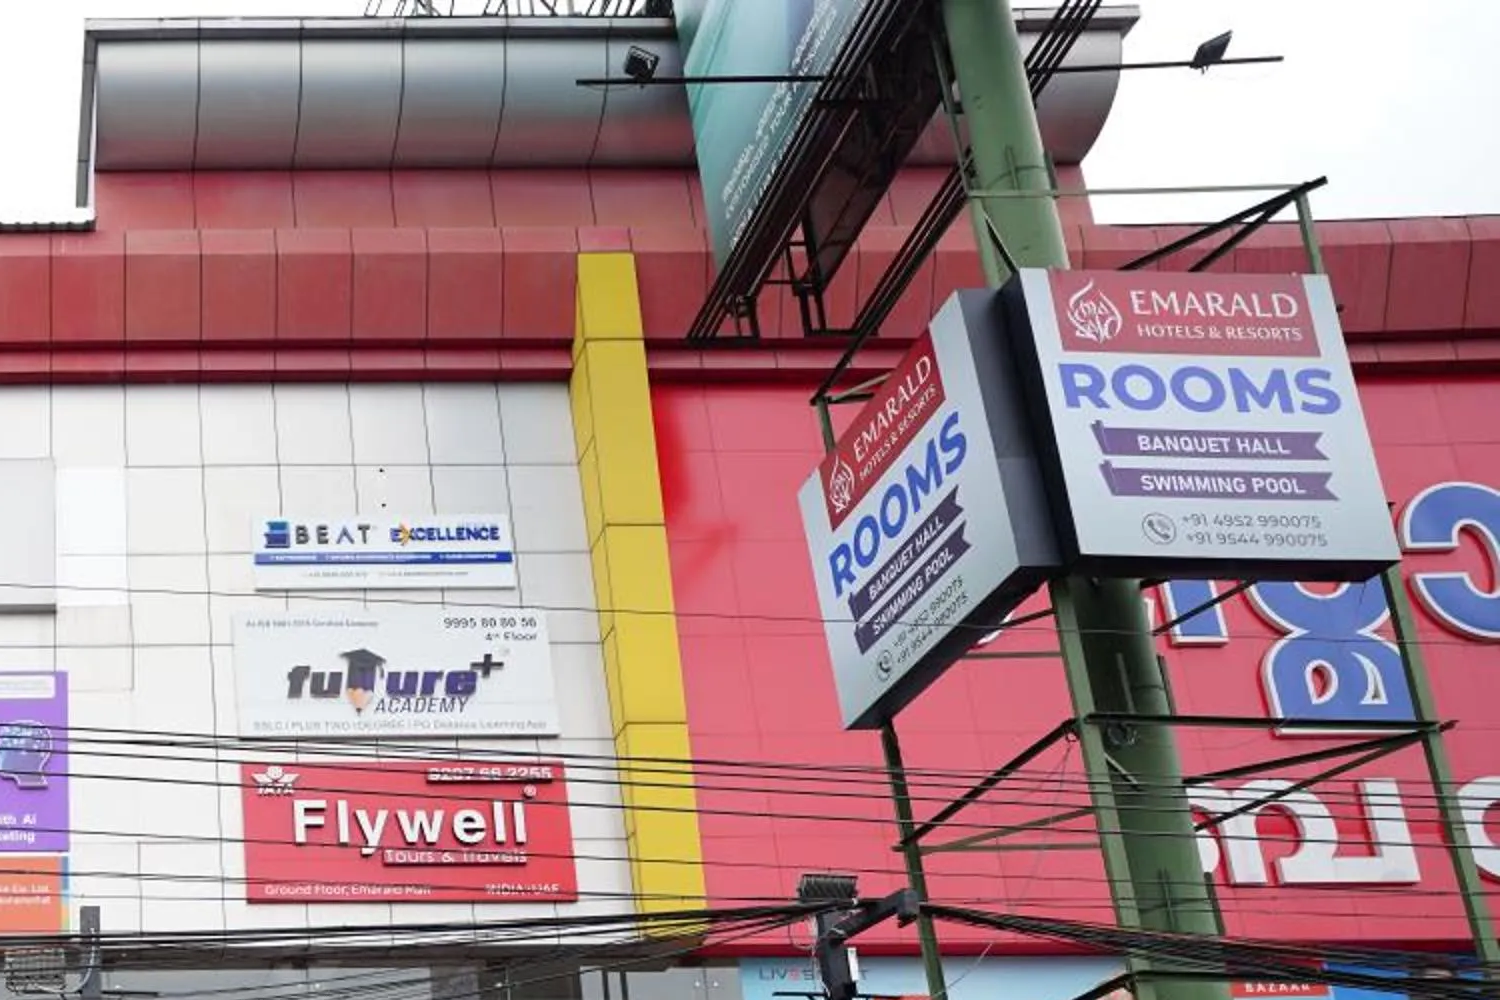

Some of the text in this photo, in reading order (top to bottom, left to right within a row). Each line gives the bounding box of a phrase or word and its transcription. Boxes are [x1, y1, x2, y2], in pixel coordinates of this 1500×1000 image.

[1130, 289, 1300, 320] EMARALD
[1137, 323, 1303, 342] HOTELS & RESORTS
[1057, 361, 1342, 415] ROOMS
[853, 354, 931, 463] EMARALD
[1137, 434, 1292, 455] BANQUET HALL
[859, 435, 889, 482] HOTELS
[1140, 474, 1307, 495] SWIMMING POOL
[828, 410, 968, 599] ROOMS
[1182, 513, 1322, 529] +91 4952 990075
[295, 524, 501, 546] BEAT EXCELLENCE
[1186, 532, 1329, 548] +91 9544 990075
[868, 515, 946, 602] BANQUET HALL
[871, 547, 955, 637] SWIMMING POOL
[443, 617, 478, 630] 9995
[375, 696, 471, 714] ACADEMY
[293, 799, 528, 856] Flywell
[384, 850, 435, 863] Tours
[441, 851, 455, 863] &
[264, 884, 312, 896] Ground
